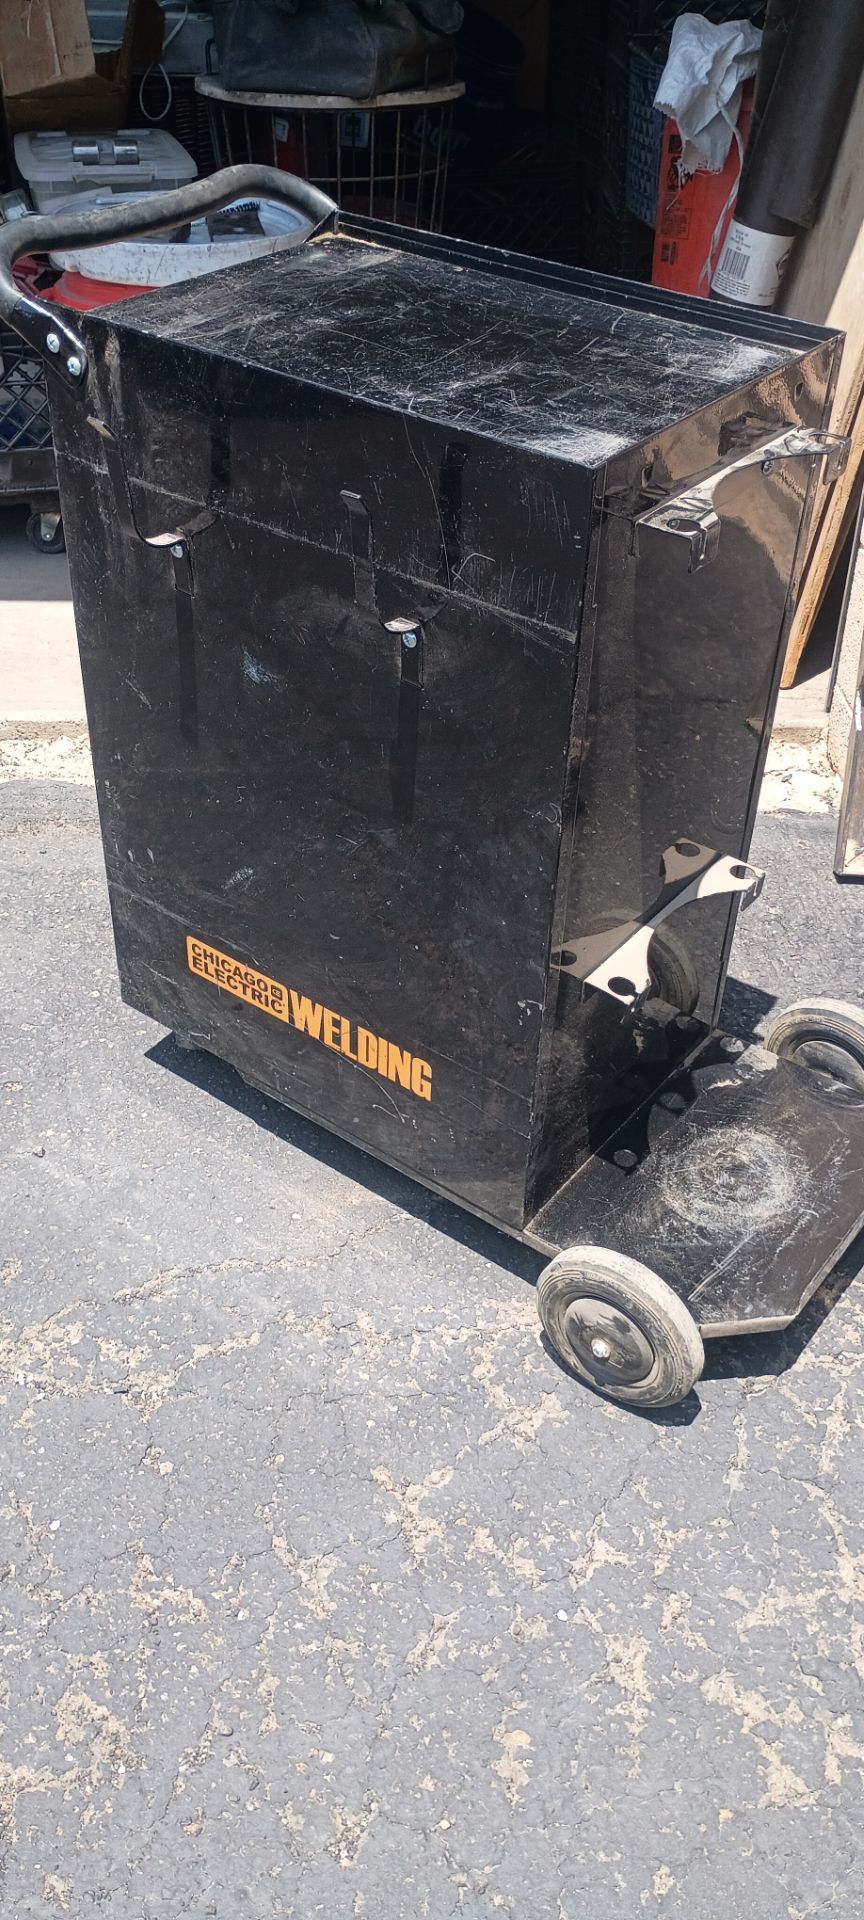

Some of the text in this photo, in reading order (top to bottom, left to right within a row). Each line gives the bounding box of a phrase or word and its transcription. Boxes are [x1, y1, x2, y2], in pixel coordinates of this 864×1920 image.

[192, 943, 269, 993] CHICAGO
[192, 955, 283, 1014] ELECTRIC
[290, 989, 433, 1102] WELDING
